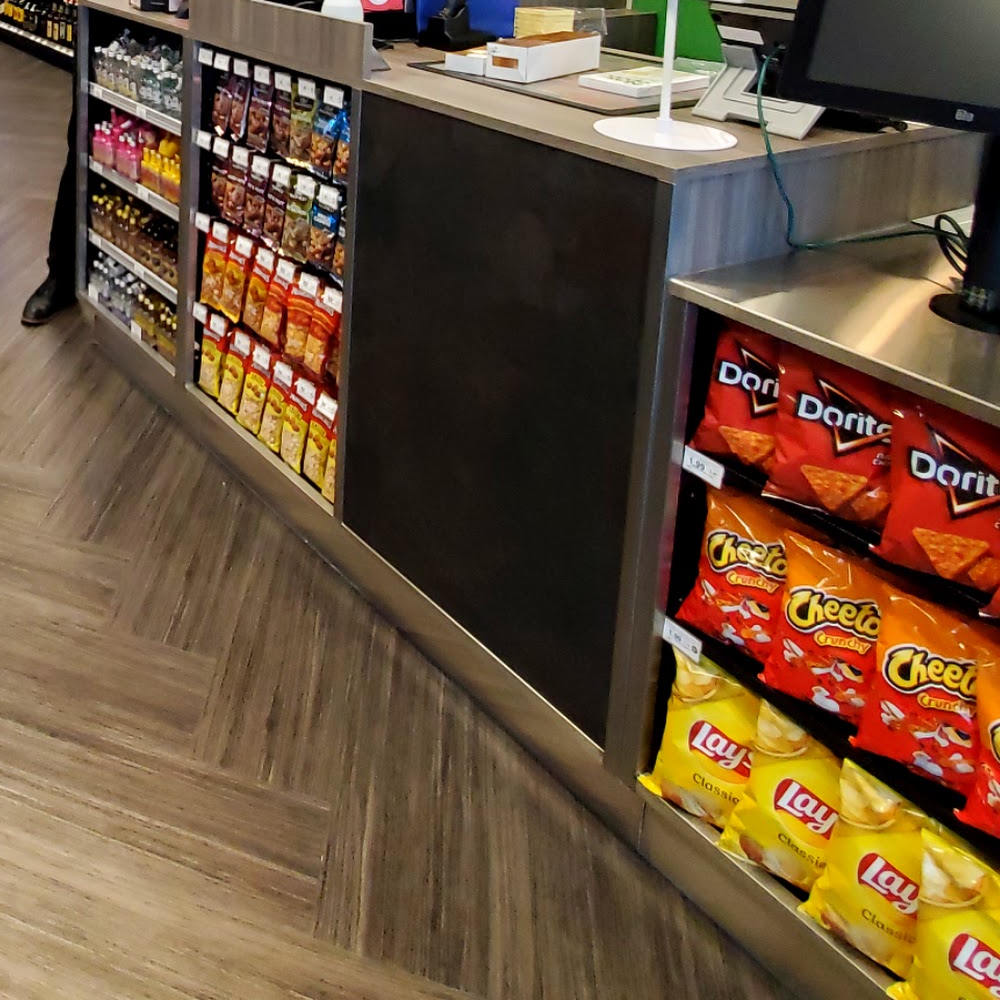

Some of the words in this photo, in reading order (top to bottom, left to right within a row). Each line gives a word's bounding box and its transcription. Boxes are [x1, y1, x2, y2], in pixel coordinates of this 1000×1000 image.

[727, 571, 779, 593] Crunchy
[814, 631, 871, 654] Crunchy
[887, 648, 977, 696] Cheet
